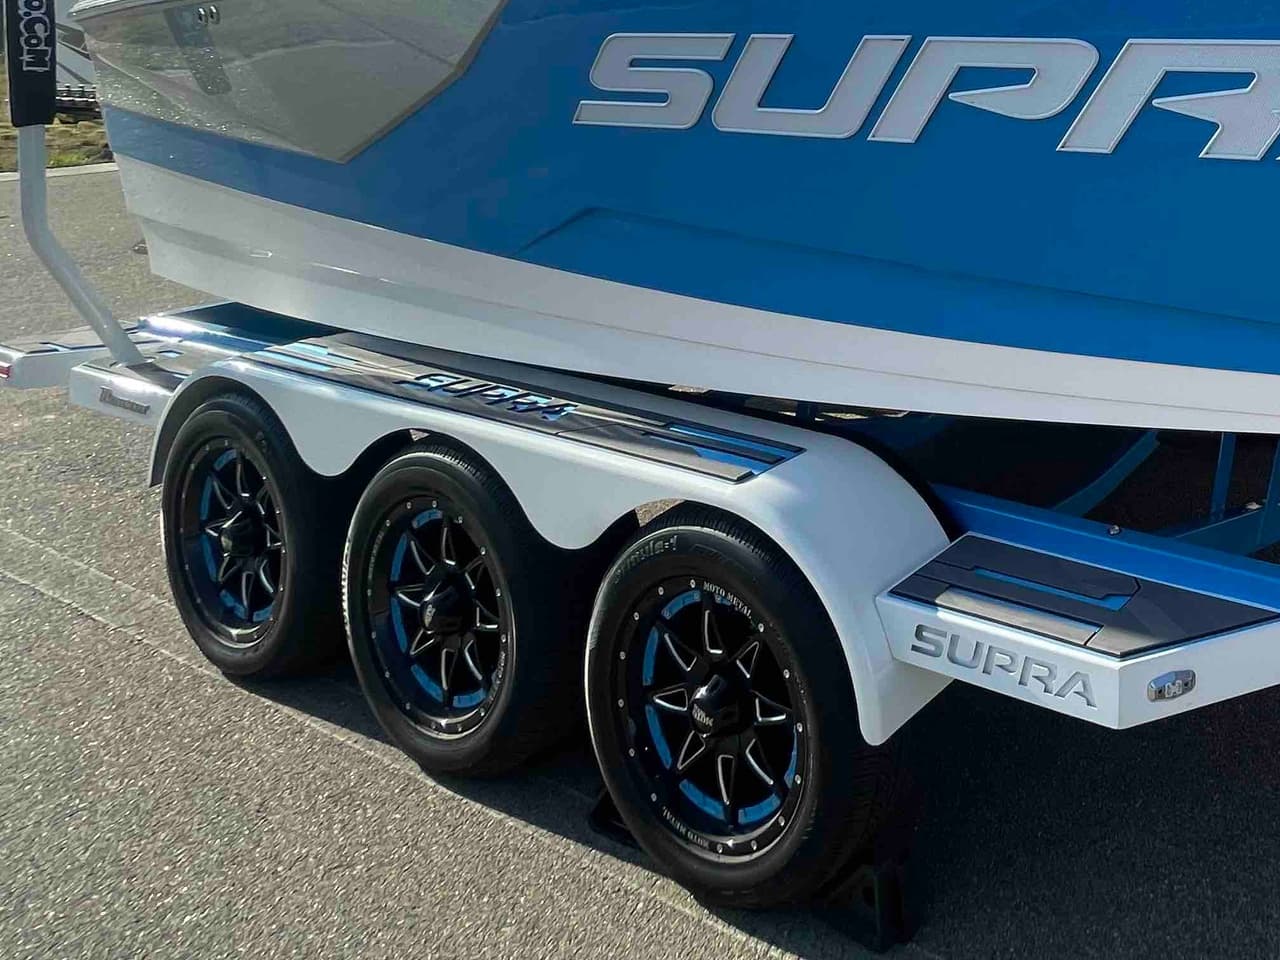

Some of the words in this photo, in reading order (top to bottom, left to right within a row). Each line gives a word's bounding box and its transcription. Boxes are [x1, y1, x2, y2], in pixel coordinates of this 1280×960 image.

[703, 581, 726, 599] MOTO
[726, 593, 752, 620] METAL
[911, 624, 1097, 708] SUPRA
